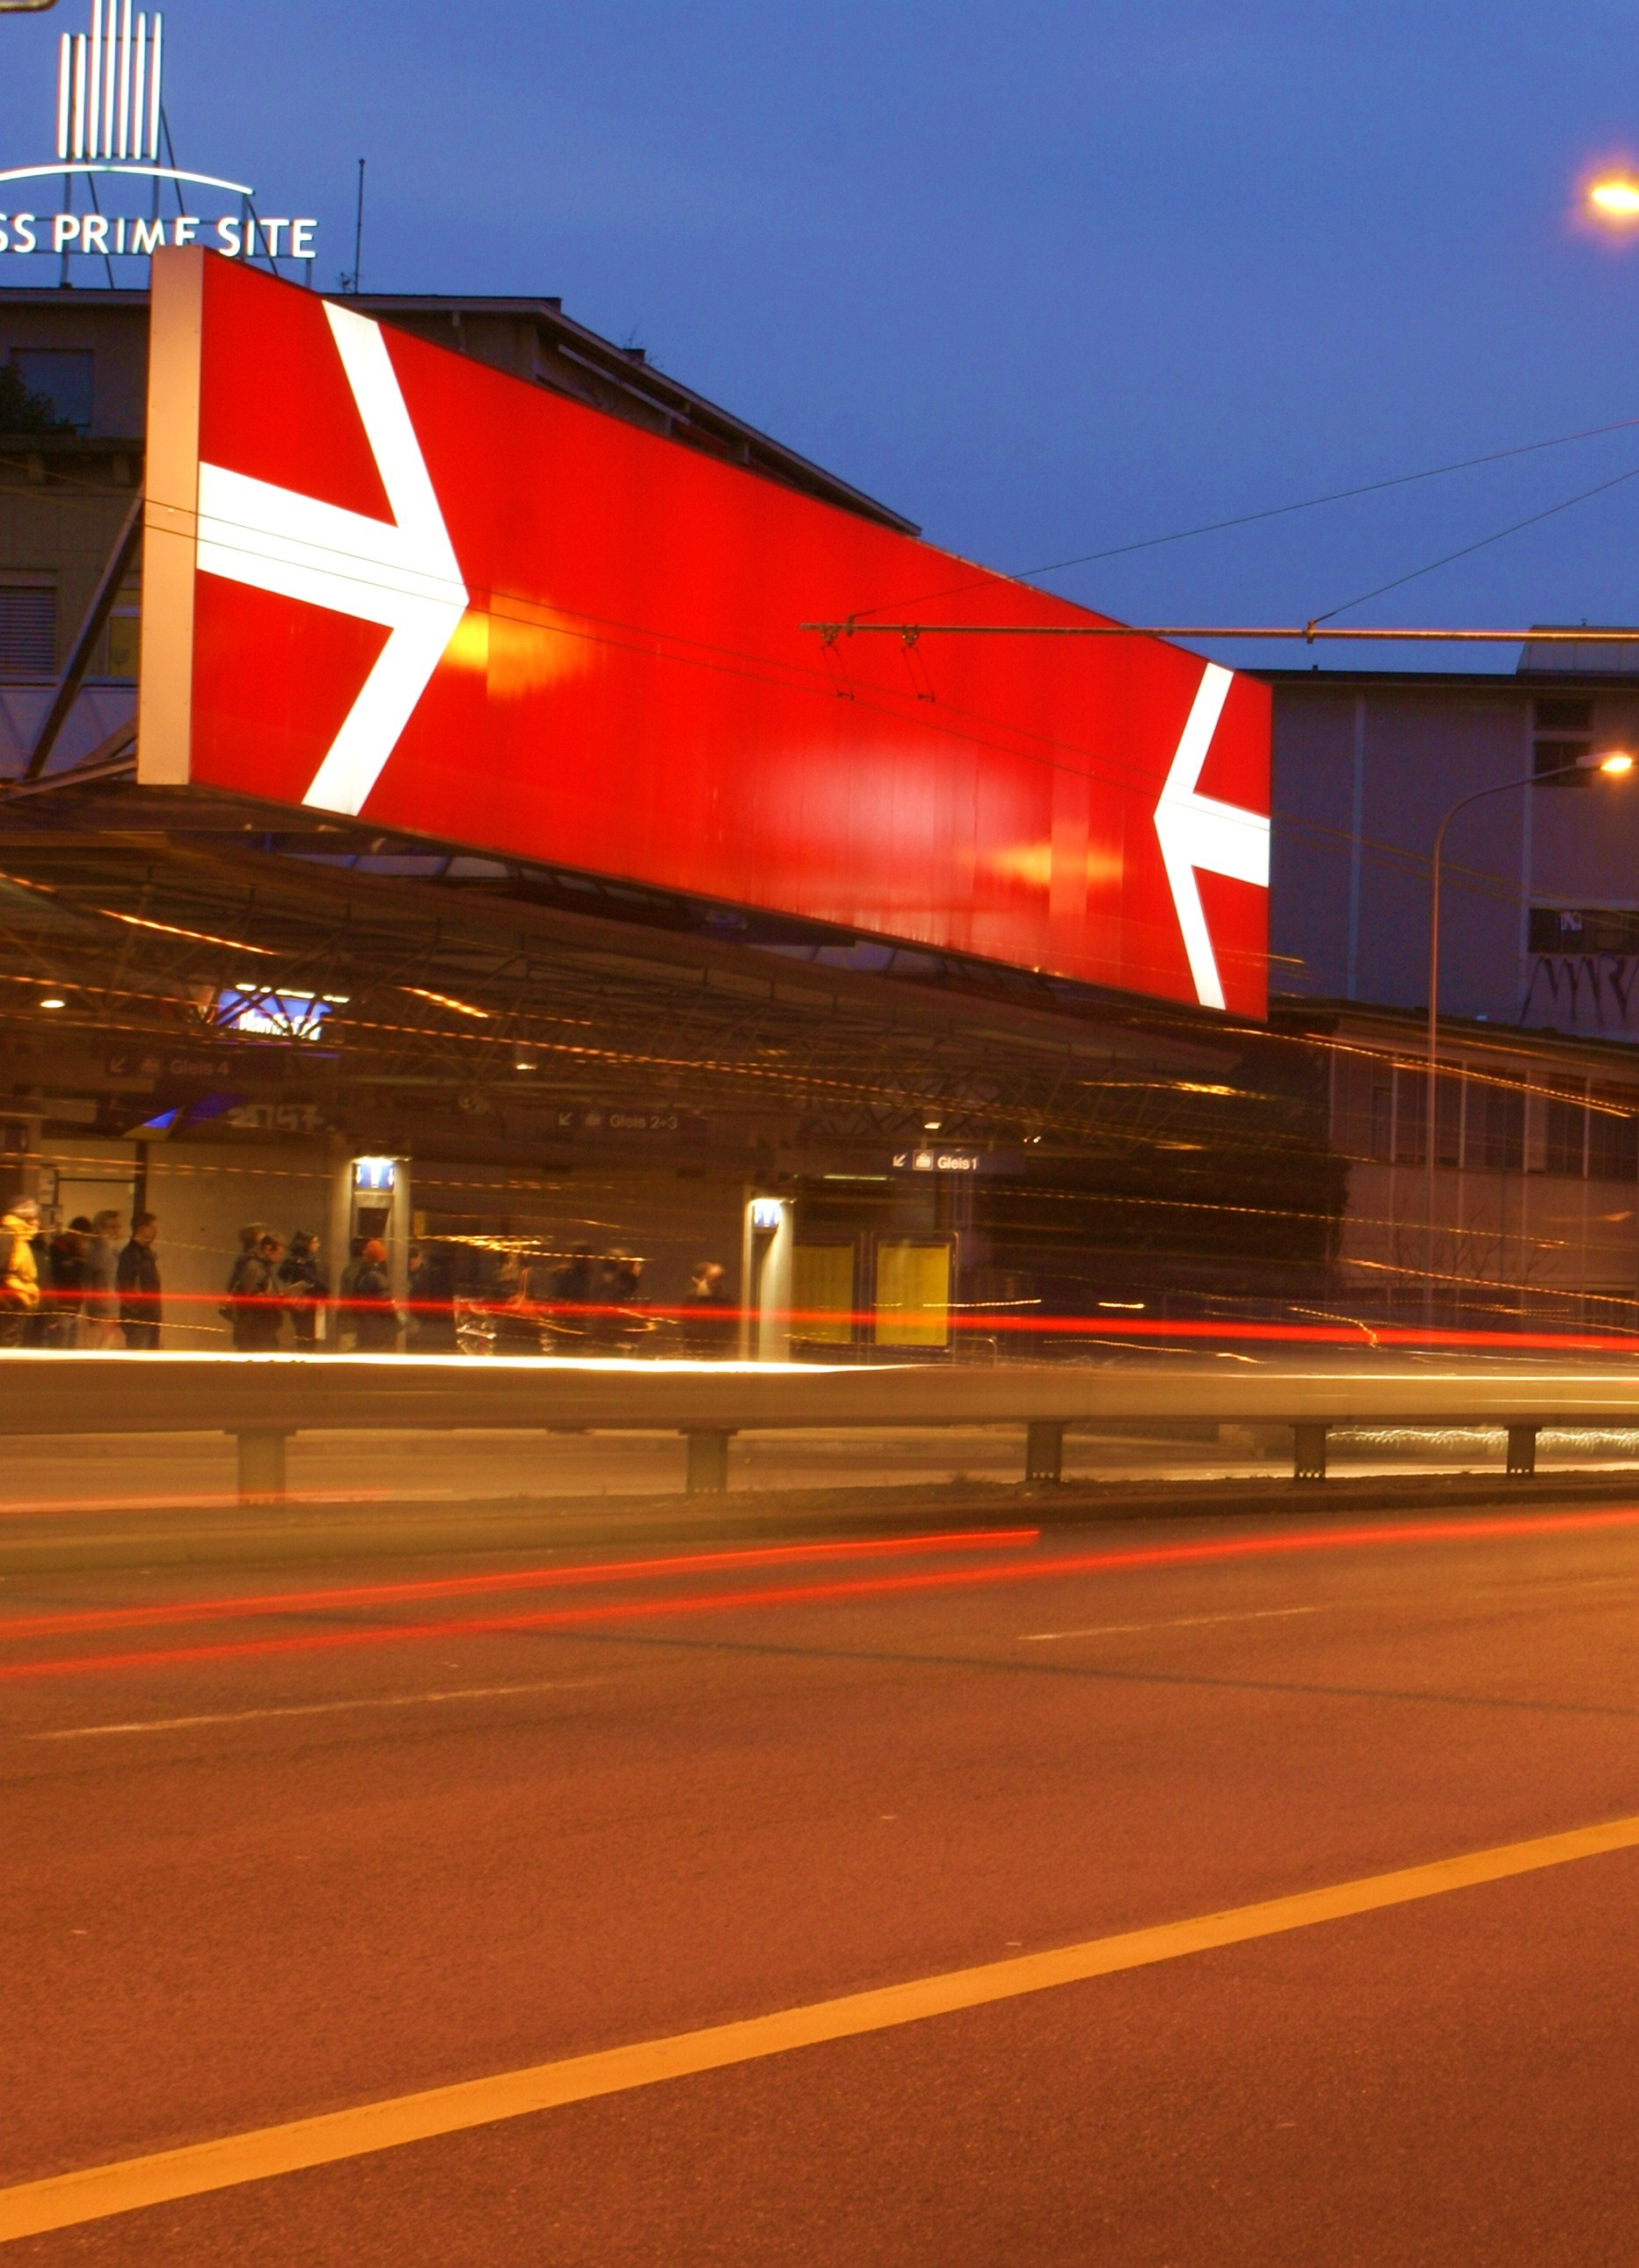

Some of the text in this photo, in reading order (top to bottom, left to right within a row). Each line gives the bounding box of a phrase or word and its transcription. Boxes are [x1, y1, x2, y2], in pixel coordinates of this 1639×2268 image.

[216, 216, 317, 259] SITE
[171, 1059, 230, 1076] Gleis 4
[609, 1113, 646, 1129] Gleis
[937, 1156, 978, 1170] Gleis 1
